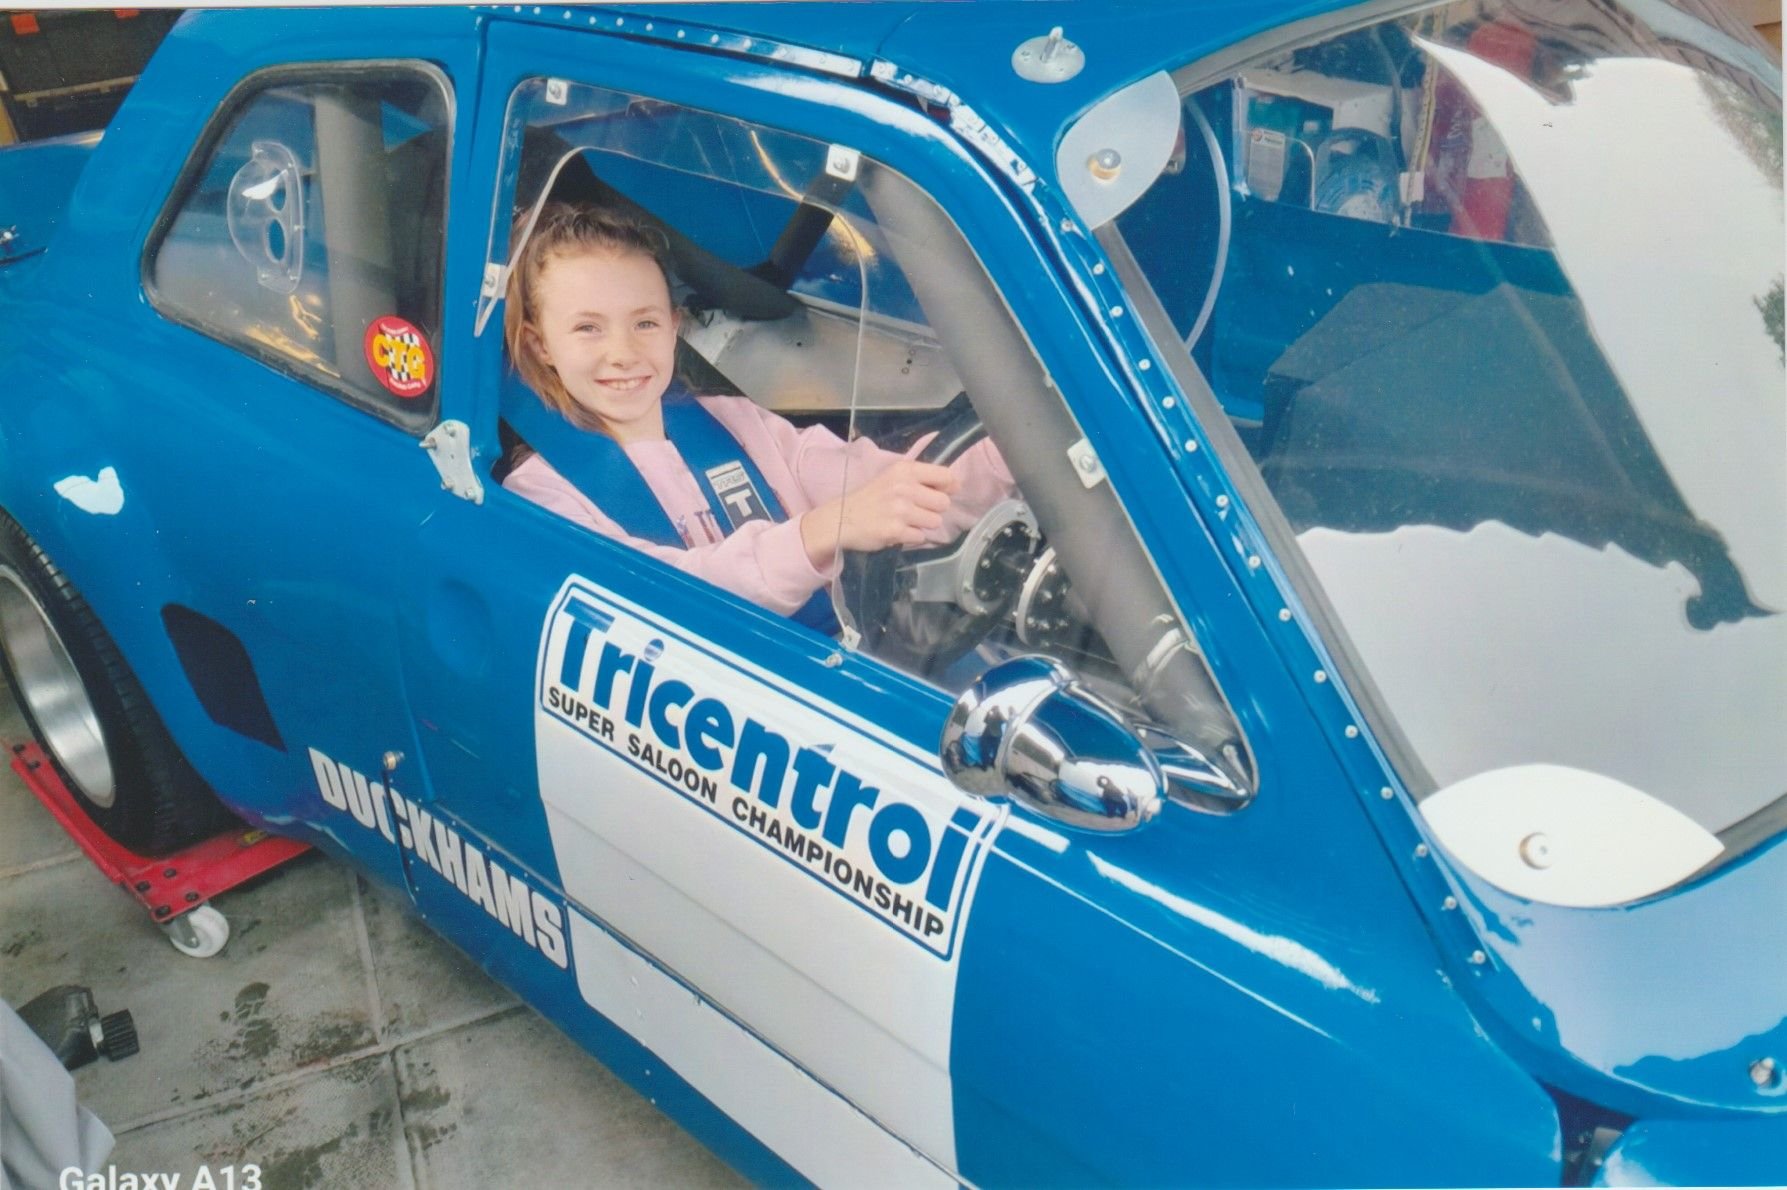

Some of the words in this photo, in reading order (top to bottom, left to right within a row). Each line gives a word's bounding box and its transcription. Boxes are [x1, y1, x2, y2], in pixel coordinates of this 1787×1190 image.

[372, 334, 426, 381] CTG
[308, 747, 568, 969] DUCKHAMS
[548, 686, 615, 742] SUPER
[628, 733, 718, 804] SALOON
[732, 797, 944, 938] CHAMPIONSHIP
[559, 596, 982, 913] Tricentrol
